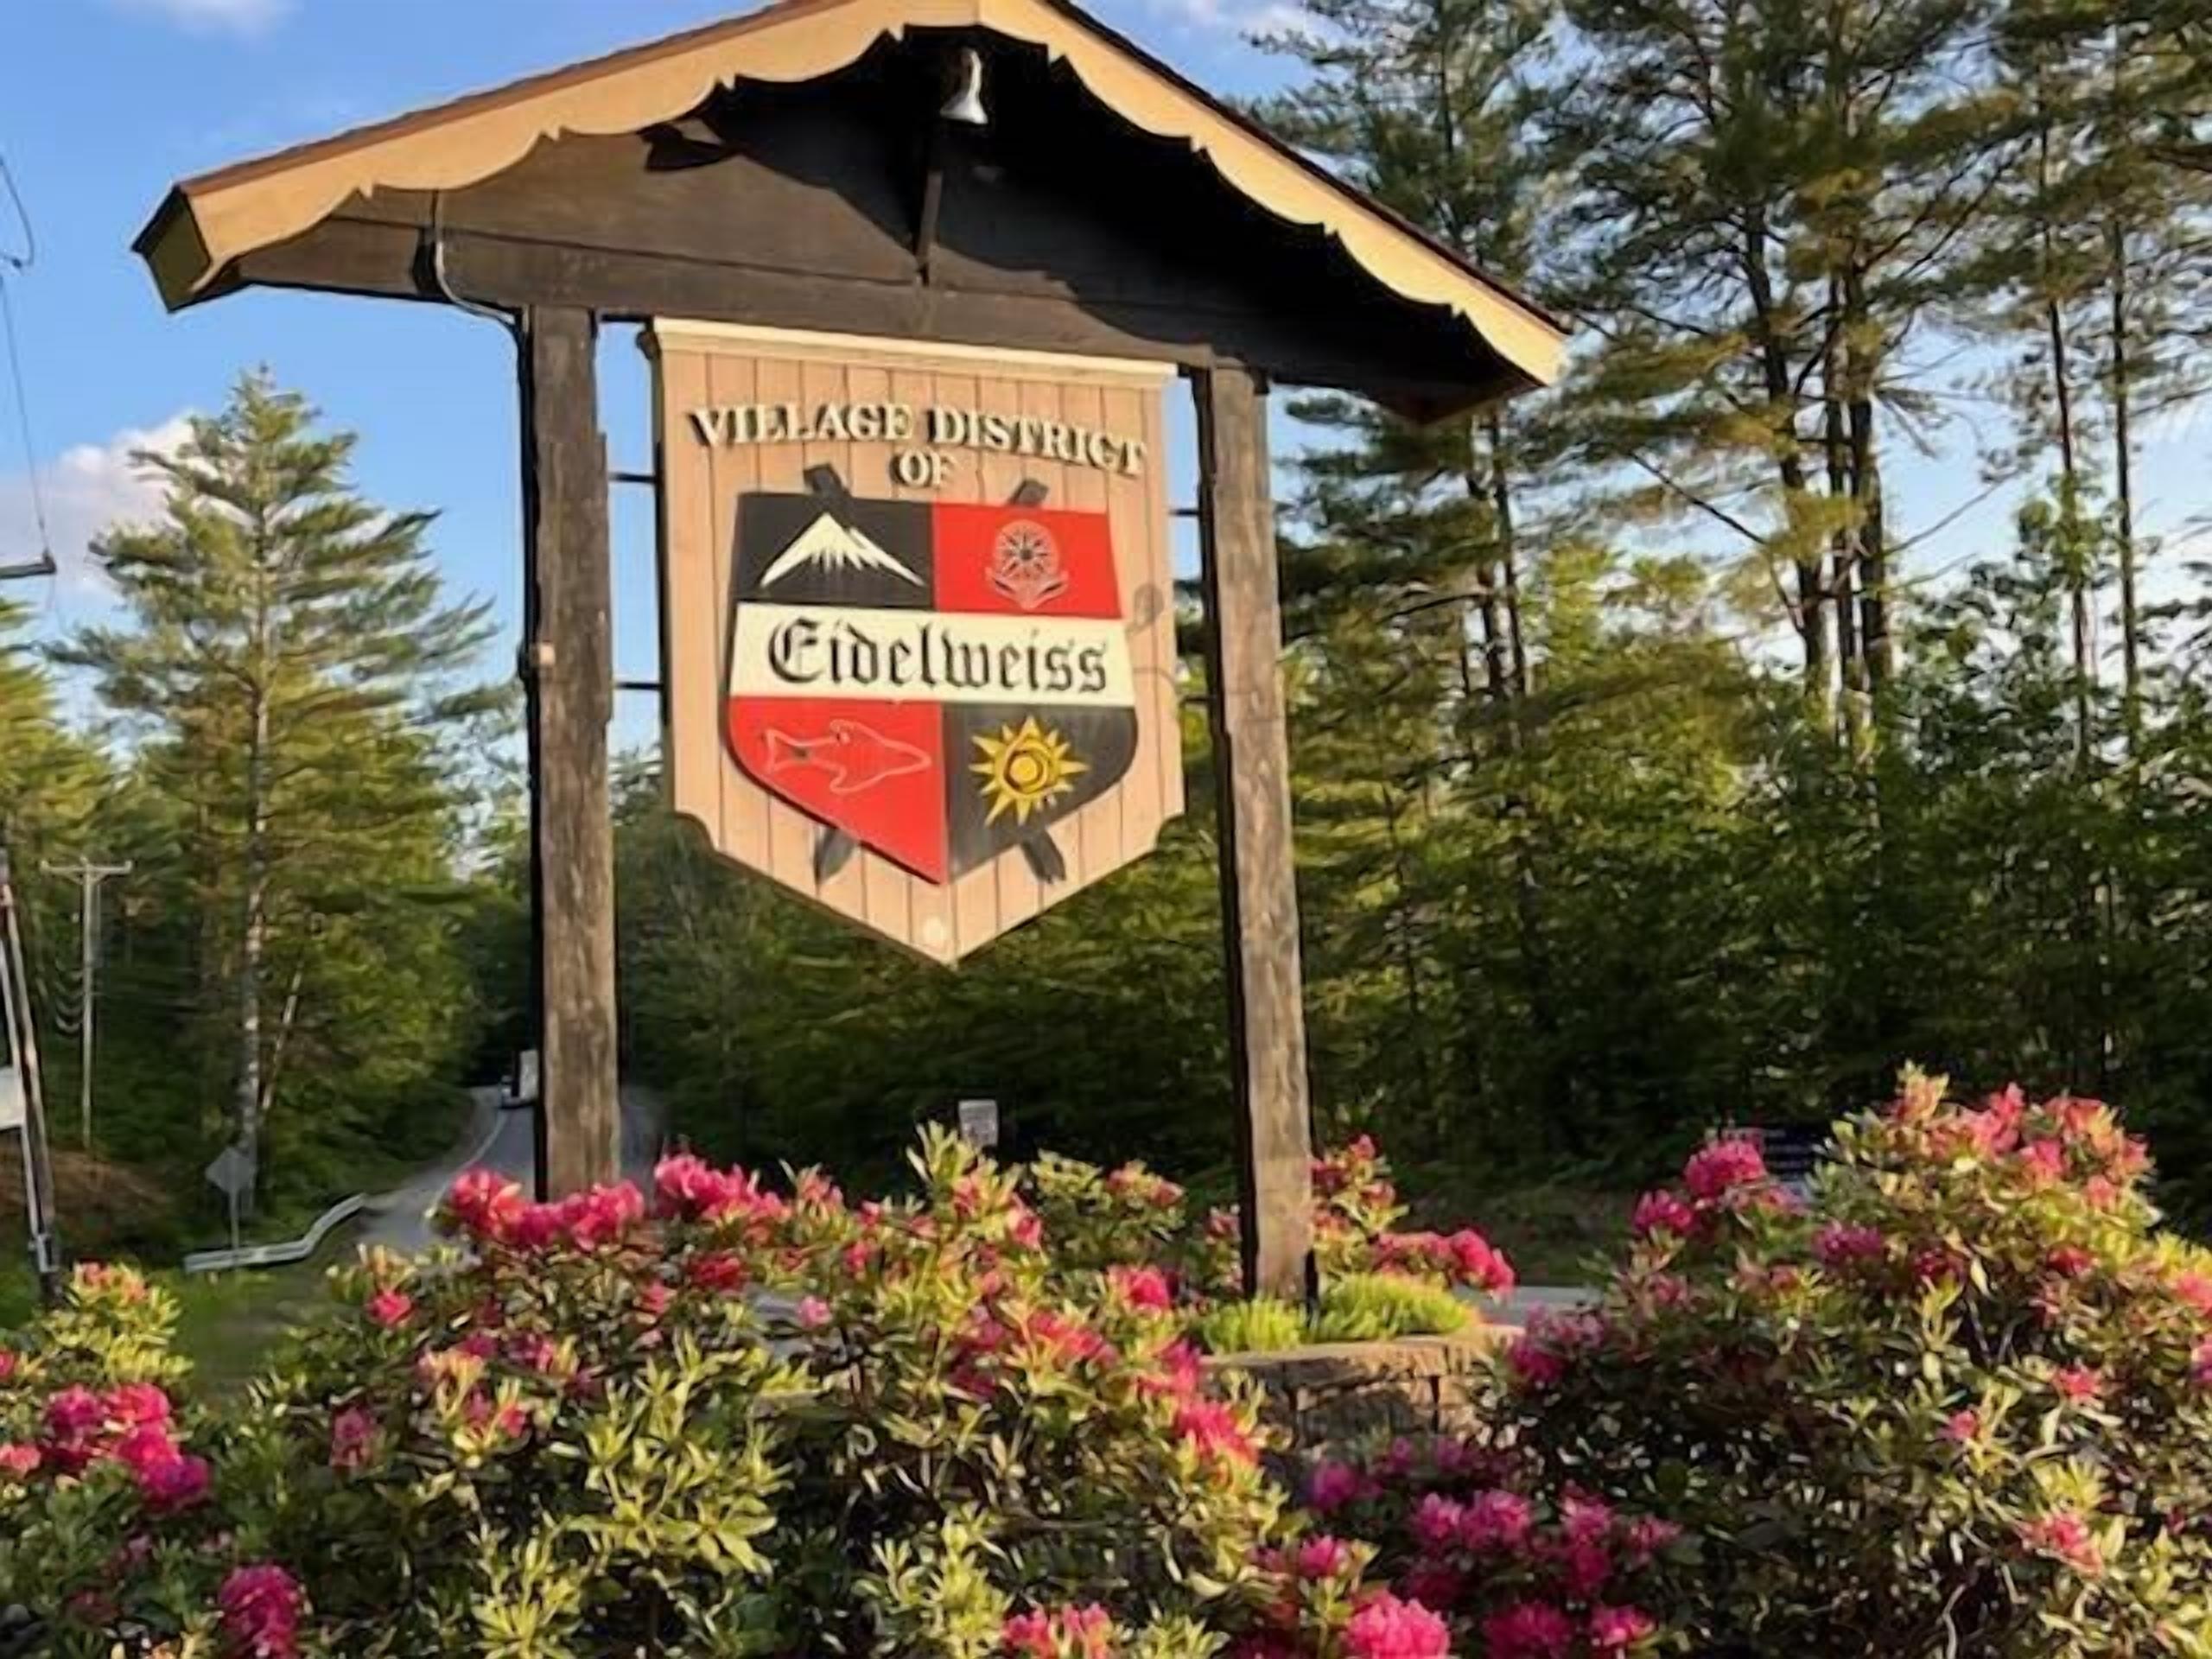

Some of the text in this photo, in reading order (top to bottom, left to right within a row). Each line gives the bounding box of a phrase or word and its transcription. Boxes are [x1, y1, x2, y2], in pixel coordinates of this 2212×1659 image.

[690, 403, 1147, 476] VILLAGE DISTRICT
[893, 448, 956, 486] OF
[768, 615, 1108, 694] Eidelweiss
